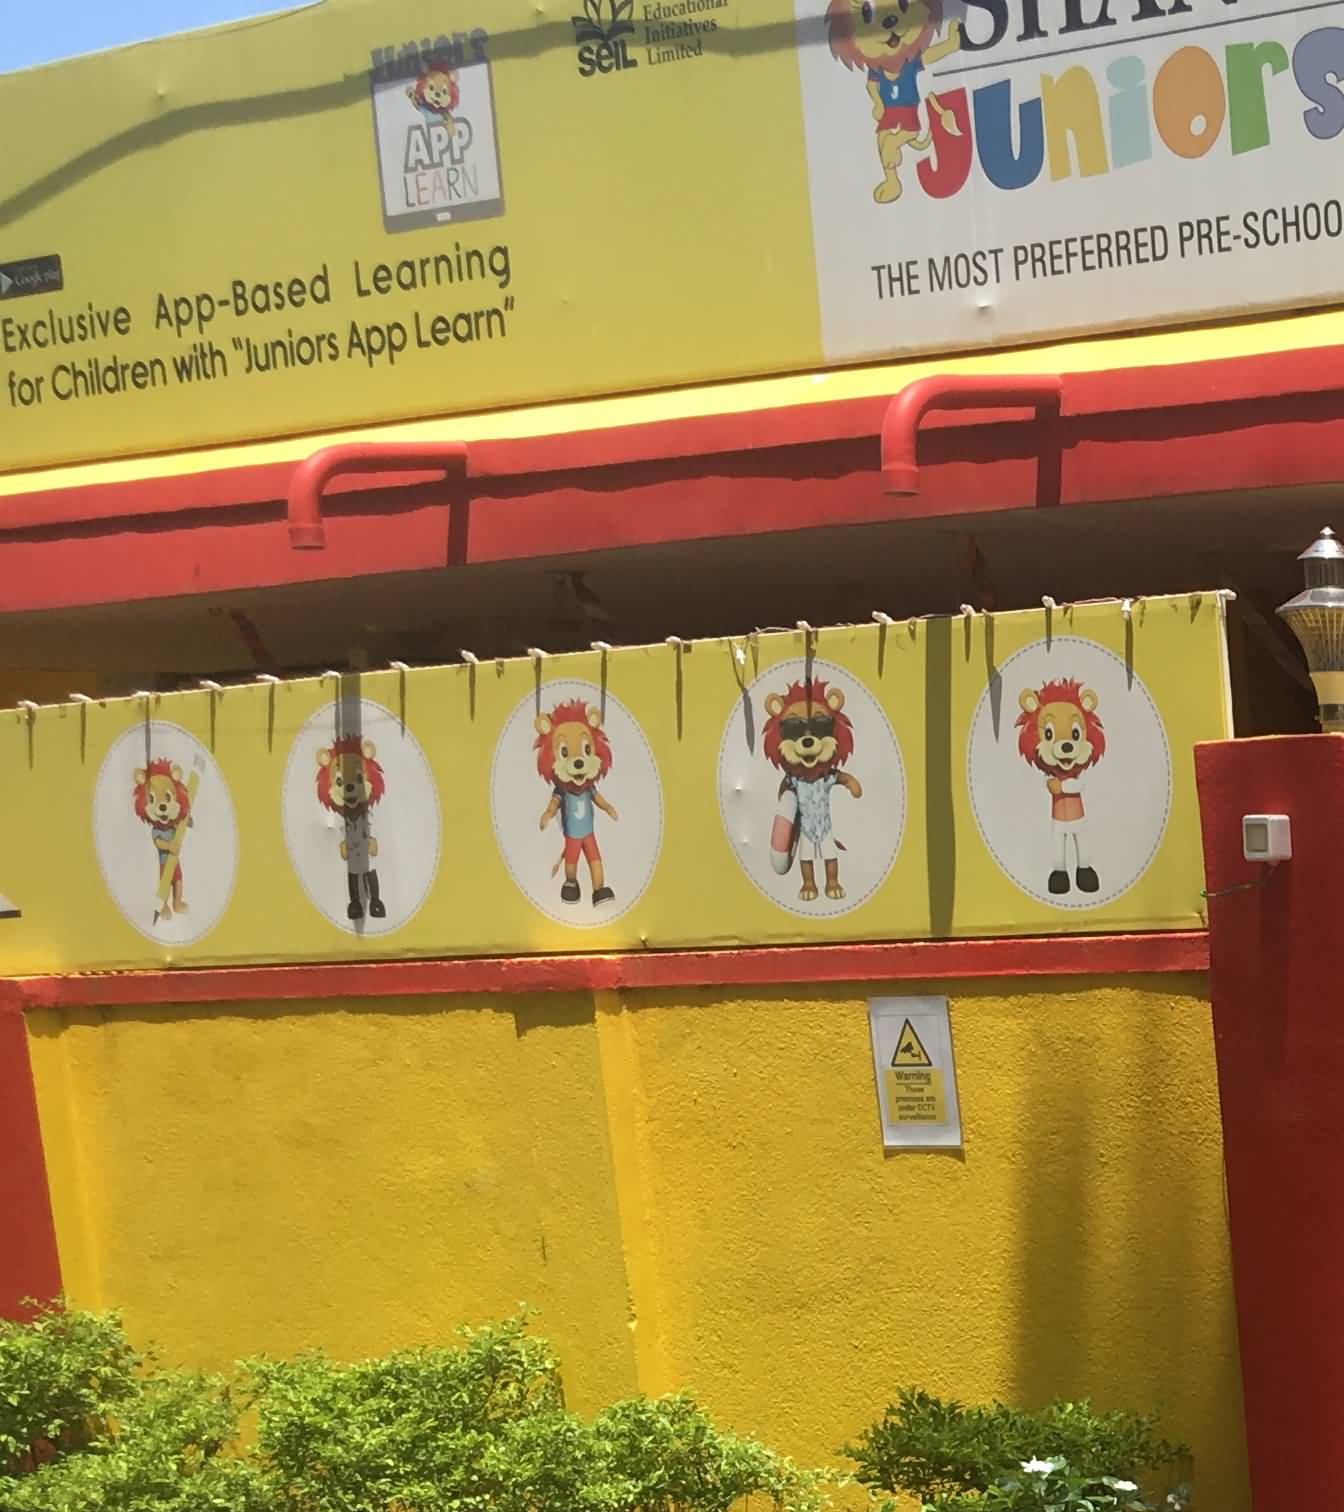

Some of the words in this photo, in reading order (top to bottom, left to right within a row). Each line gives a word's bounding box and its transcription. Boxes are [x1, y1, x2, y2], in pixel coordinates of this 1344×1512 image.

[645, 18, 717, 44] Initiatives
[646, 41, 703, 65] Limited
[404, 117, 473, 173] APP
[403, 163, 479, 208] LEARN
[871, 260, 920, 300] THE
[928, 247, 1004, 293] MOST
[1014, 224, 1169, 281] PREFERRED
[1, 302, 131, 352] Exclusive
[155, 264, 331, 338] App-Based
[354, 241, 511, 297] Learning
[8, 371, 44, 407] for
[52, 355, 167, 400] Children
[173, 341, 227, 384] with
[232, 328, 339, 374] "Juniors
[347, 321, 408, 368] App
[895, 1071, 931, 1085] Warning
